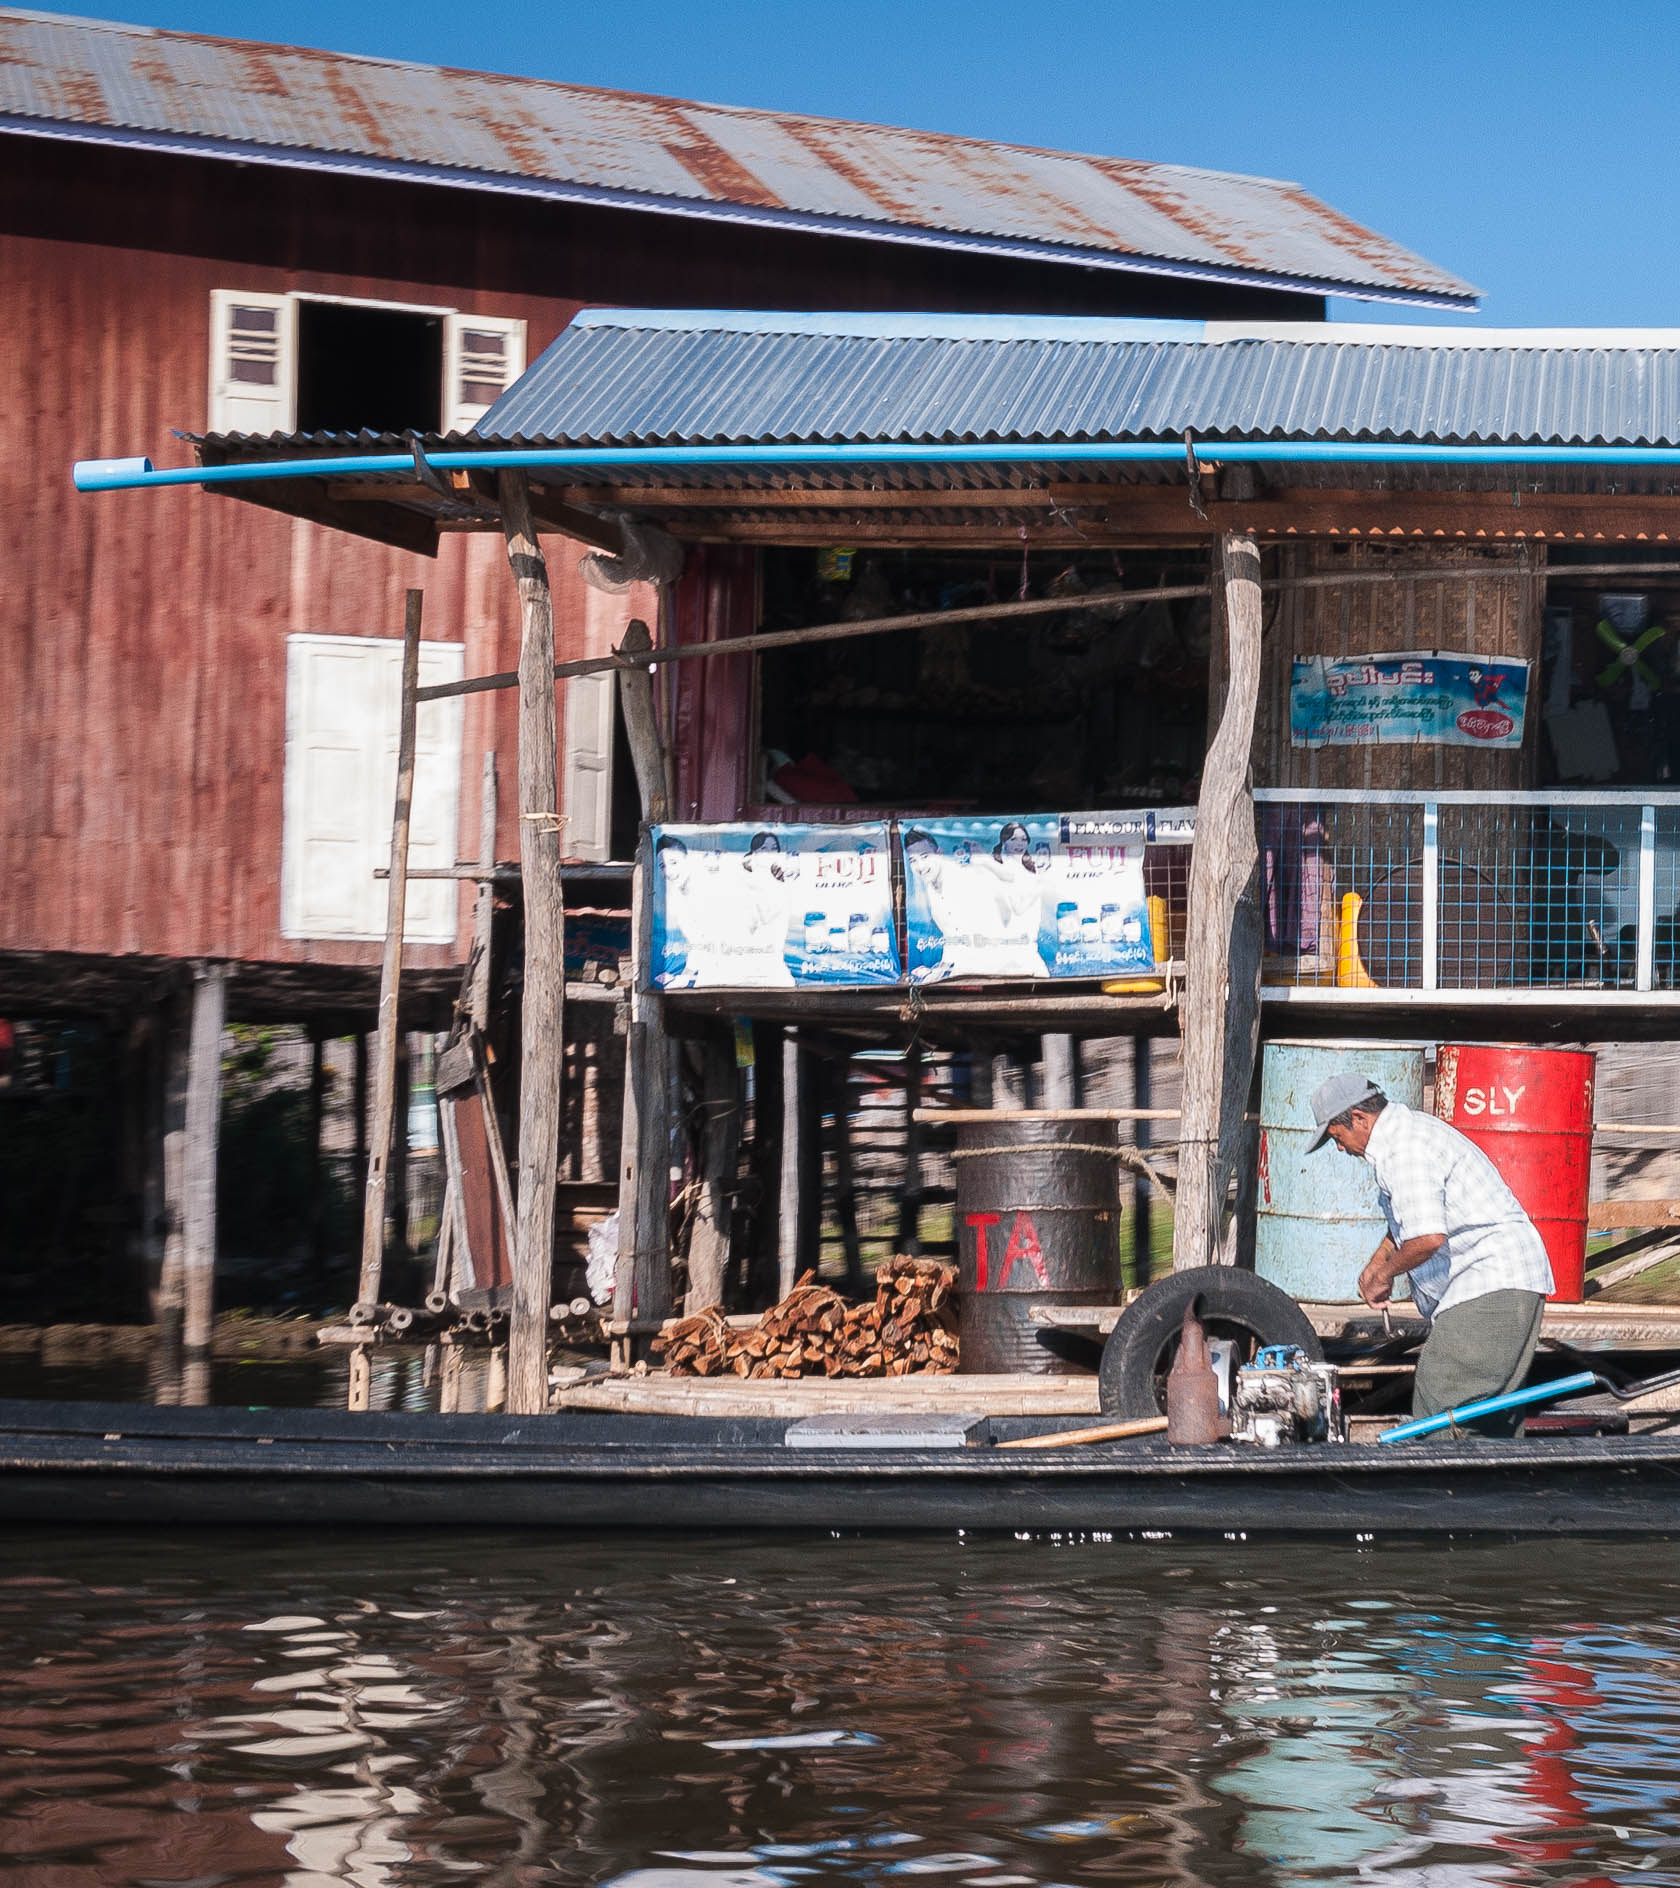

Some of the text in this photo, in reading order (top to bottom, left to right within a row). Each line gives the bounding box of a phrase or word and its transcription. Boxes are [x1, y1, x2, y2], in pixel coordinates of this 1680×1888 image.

[1074, 821, 1143, 836] FLAVOUR
[815, 851, 876, 881] FUJI
[1065, 845, 1127, 871] FUJI
[1463, 1085, 1526, 1116] SLY
[965, 1211, 1051, 1292] TA
